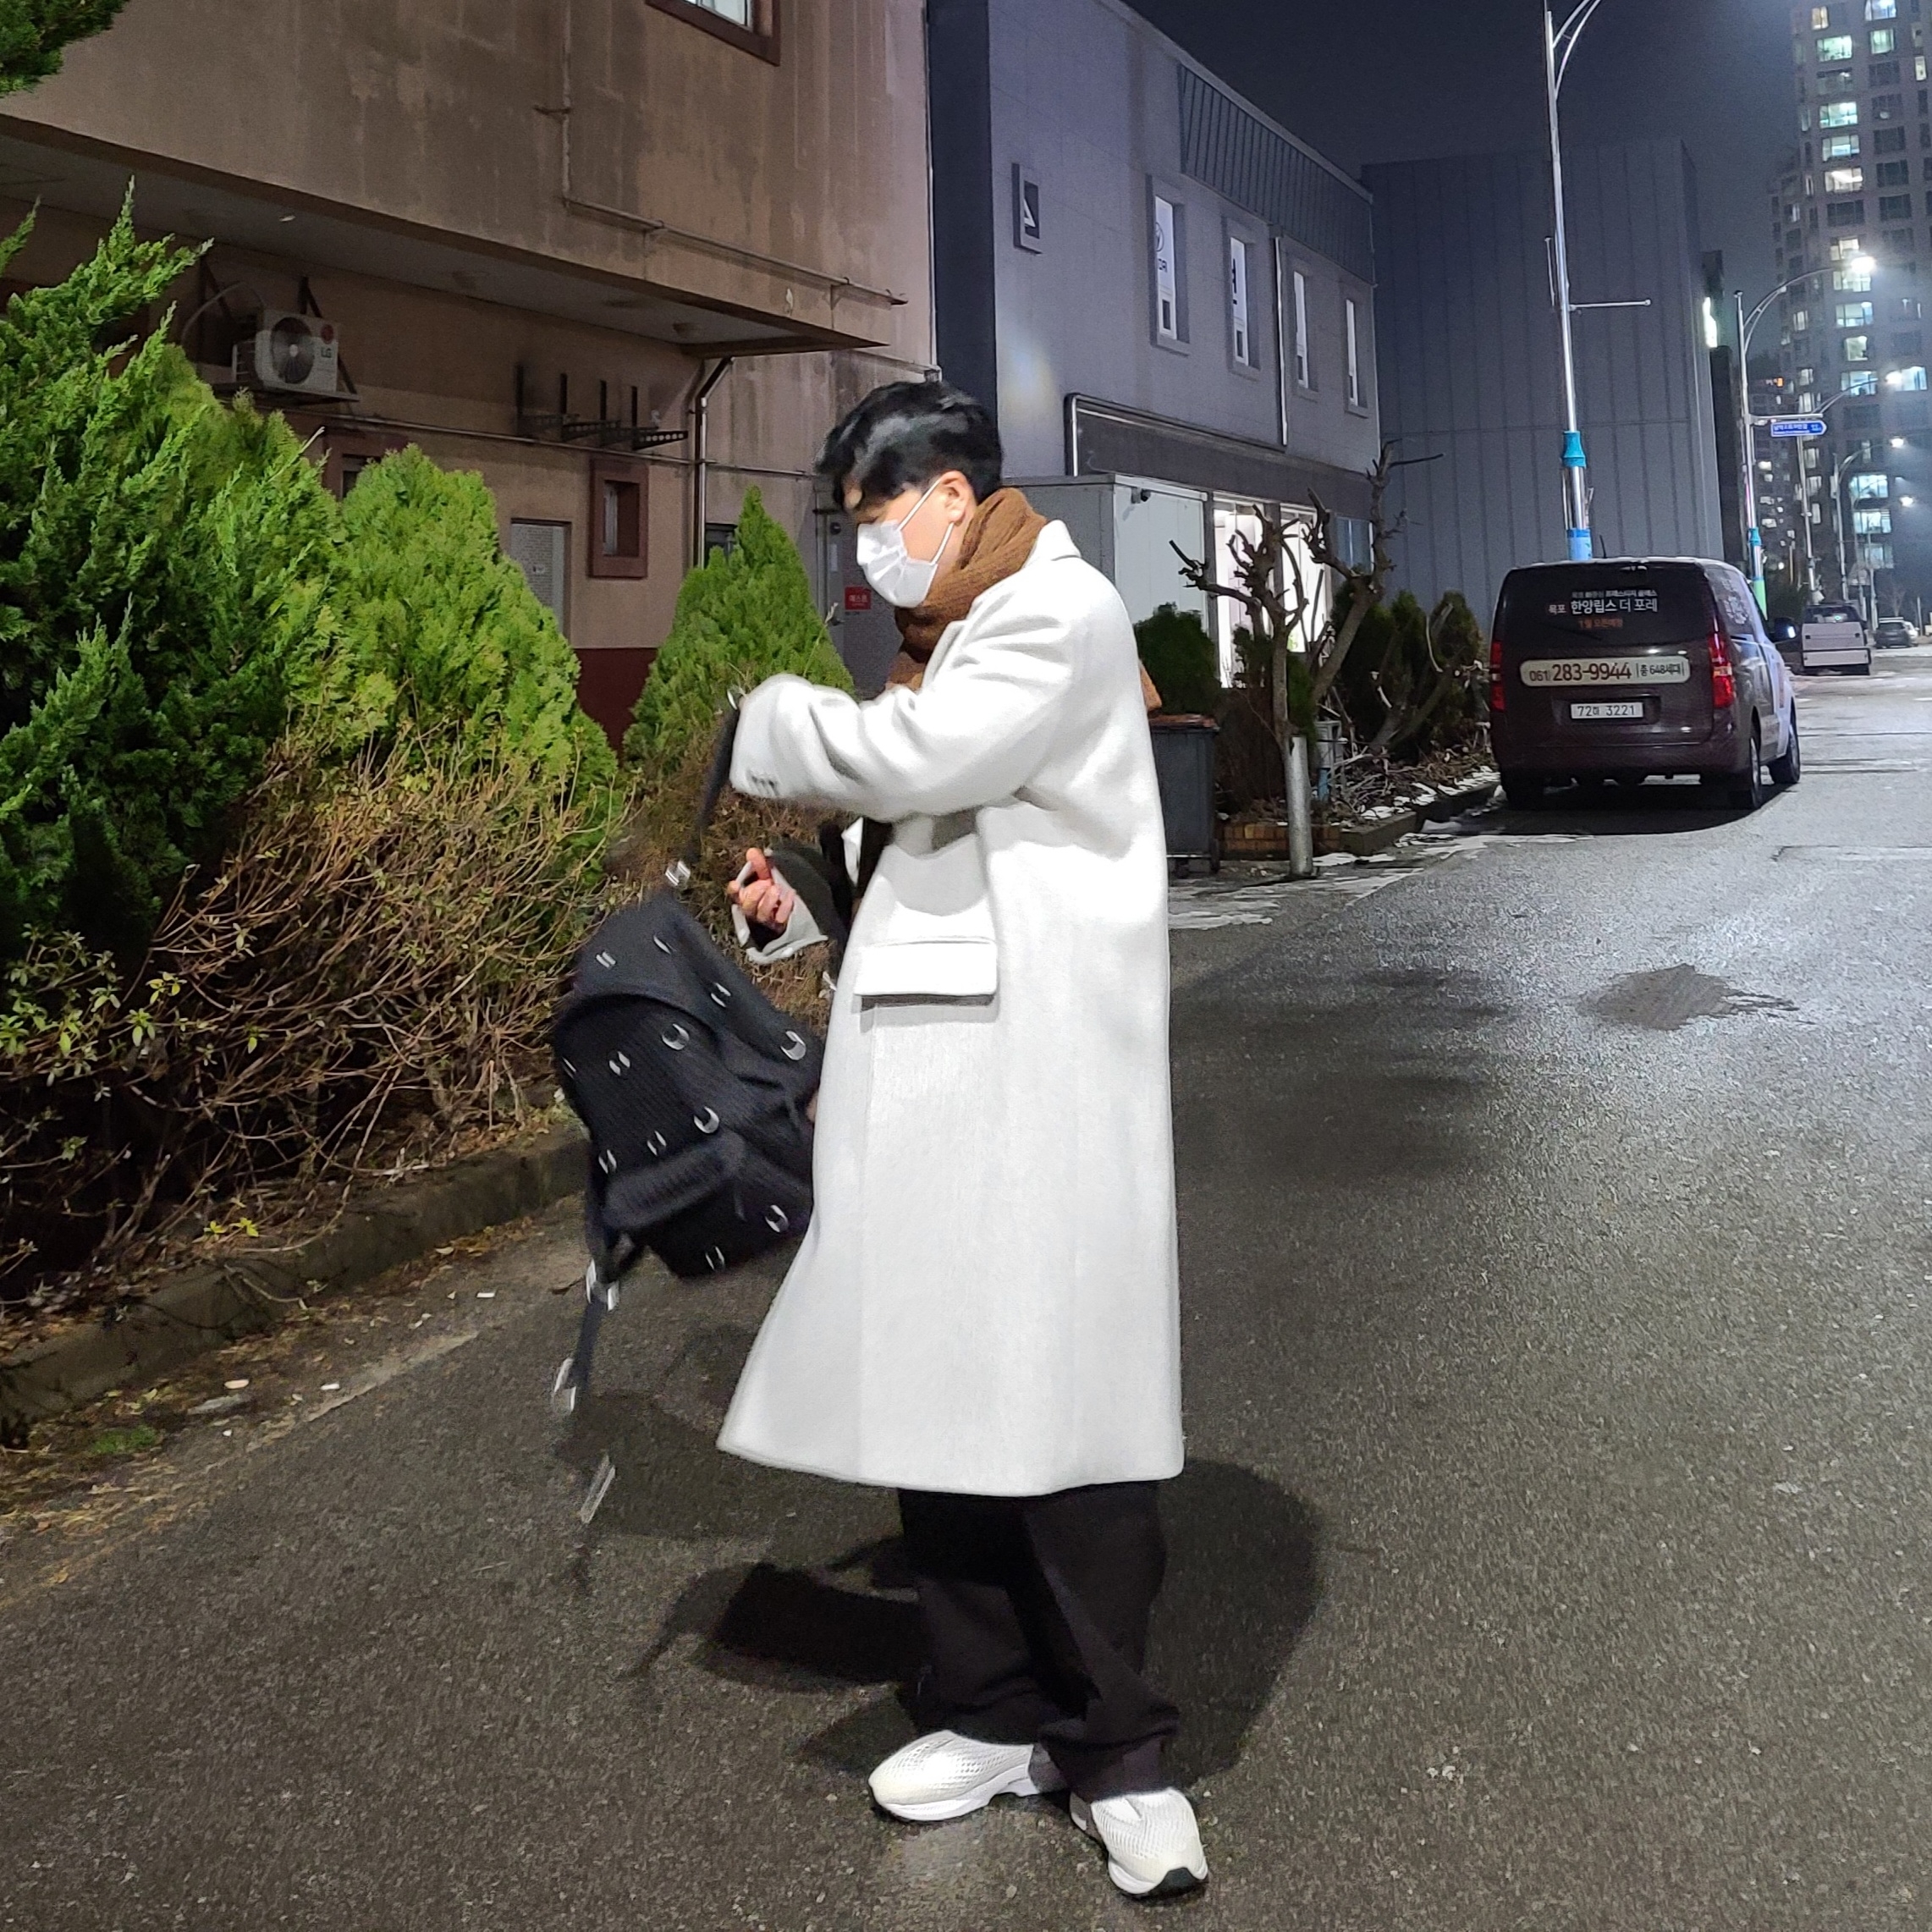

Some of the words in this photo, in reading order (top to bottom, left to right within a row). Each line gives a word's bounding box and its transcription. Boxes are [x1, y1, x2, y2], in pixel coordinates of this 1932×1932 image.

[321, 347, 332, 358] LG
[1549, 604, 1566, 615] 목포
[1571, 598, 1618, 615] 한양립스
[1619, 597, 1632, 613] 더
[1633, 597, 1658, 613] 포레
[1551, 662, 1632, 682] 283-9944
[1605, 704, 1635, 717] 3221
